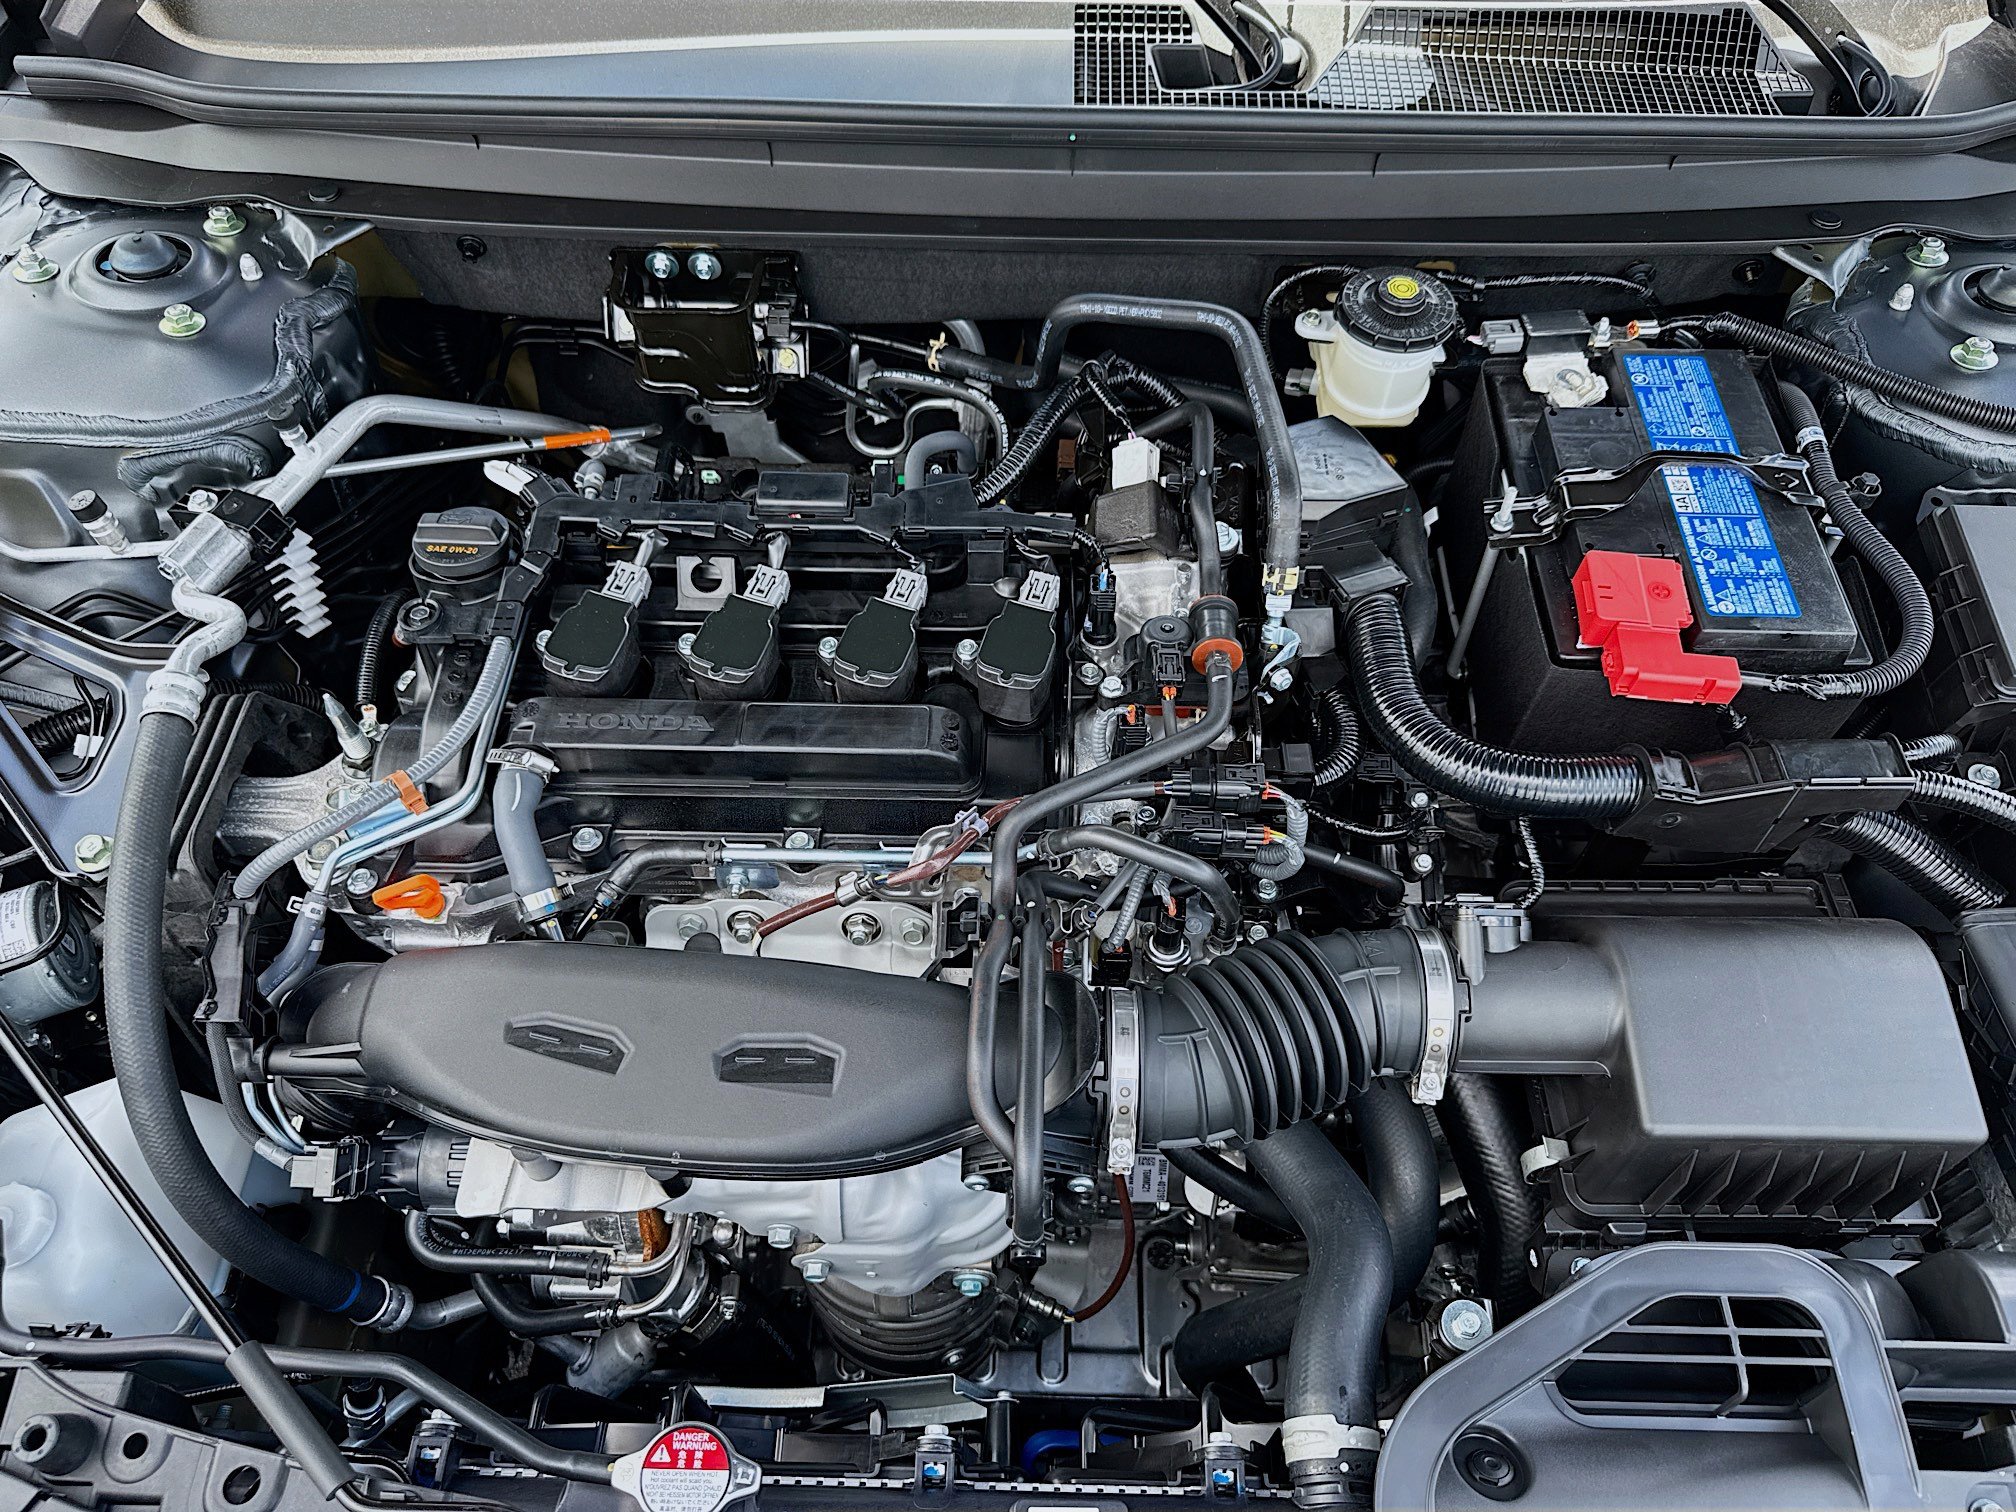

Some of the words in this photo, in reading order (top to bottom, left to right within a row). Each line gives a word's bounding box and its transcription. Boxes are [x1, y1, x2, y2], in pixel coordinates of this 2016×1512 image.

[1674, 496, 1690, 511] 4A
[426, 544, 447, 553] SAE
[448, 545, 478, 554] 0W-20
[555, 713, 714, 731] HONDA
[673, 1432, 710, 1442] DANGER
[672, 1441, 717, 1450] WARNUNG
